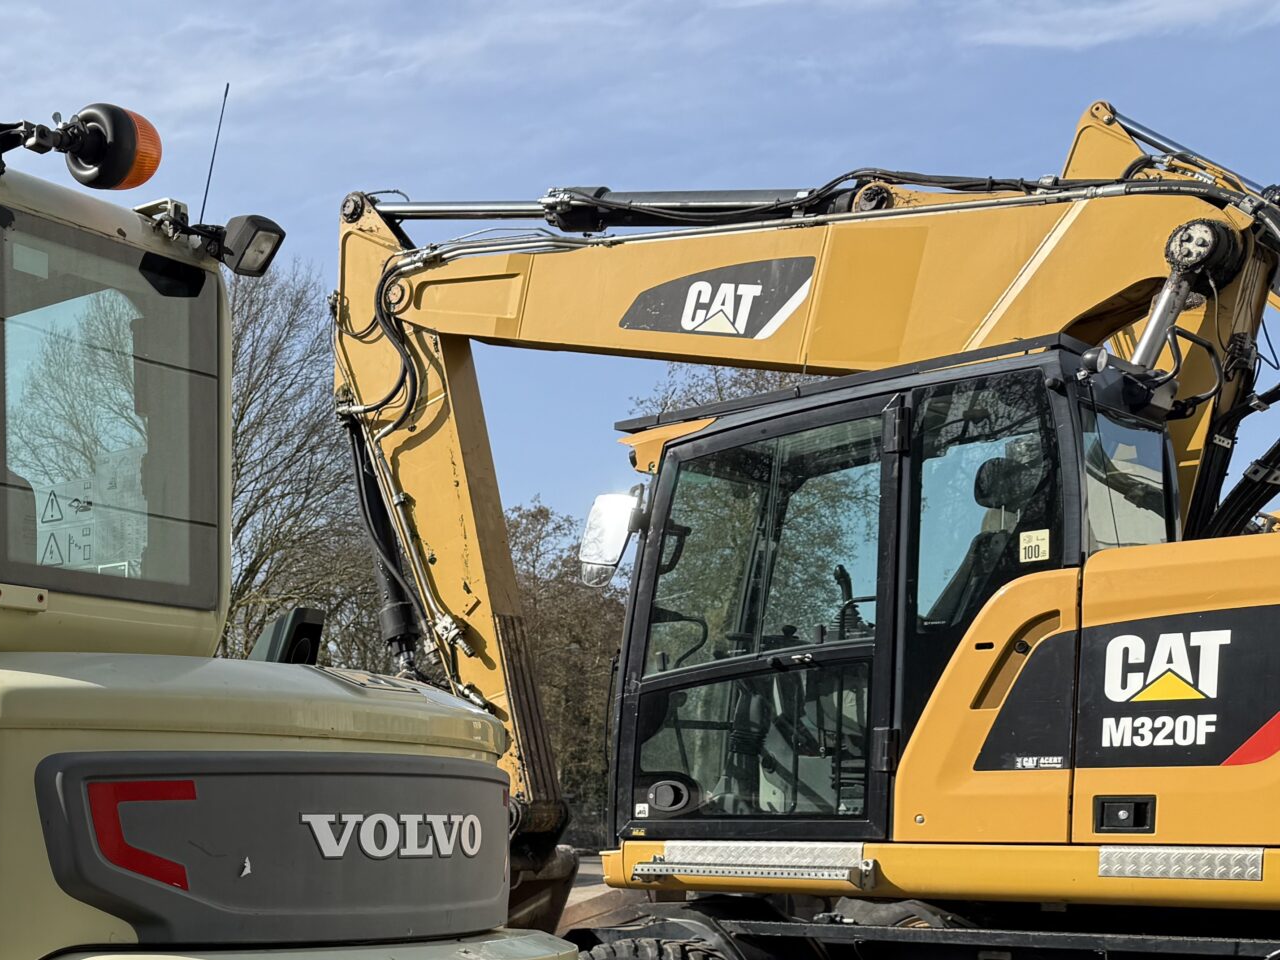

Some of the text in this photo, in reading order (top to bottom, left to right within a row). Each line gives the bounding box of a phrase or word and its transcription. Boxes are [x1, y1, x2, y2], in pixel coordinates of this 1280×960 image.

[681, 281, 763, 334] CAT
[1022, 544, 1040, 560] 100
[1104, 629, 1232, 702] CAT
[1101, 713, 1218, 747] M320F
[299, 803, 483, 859] VOLVO
